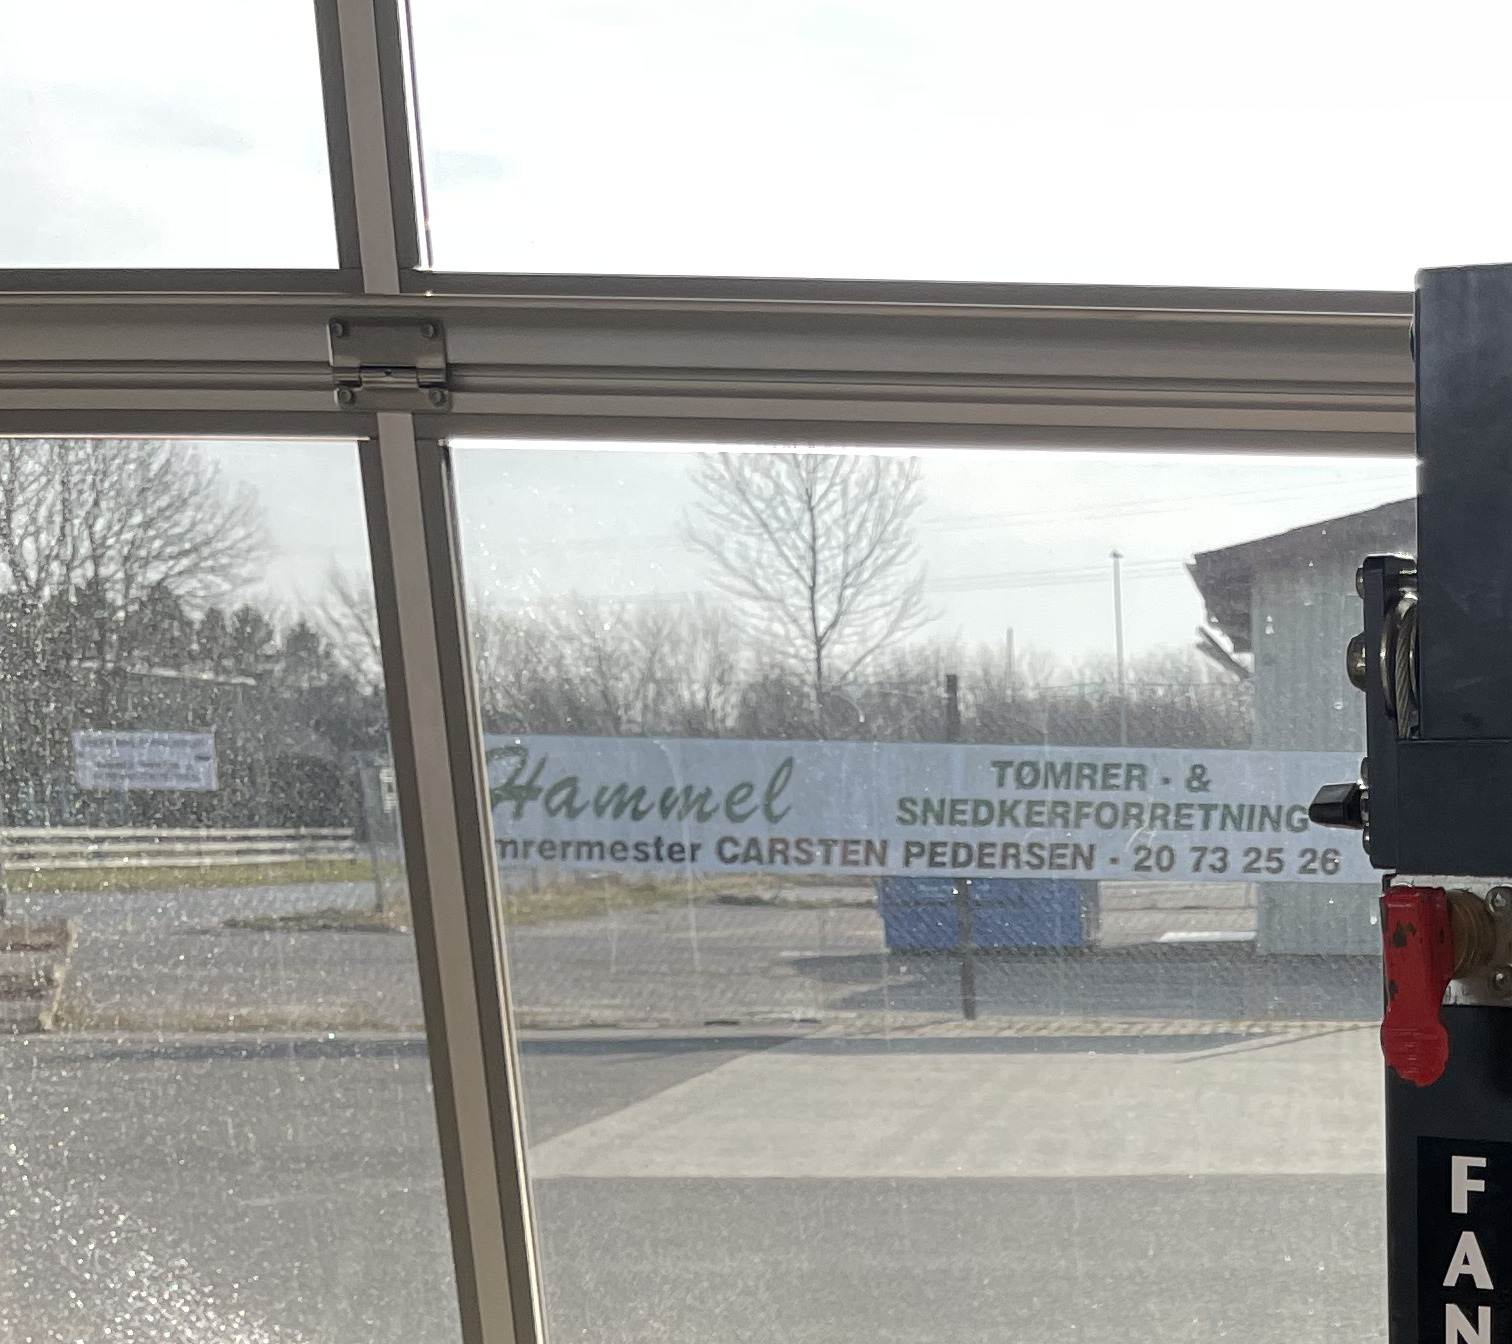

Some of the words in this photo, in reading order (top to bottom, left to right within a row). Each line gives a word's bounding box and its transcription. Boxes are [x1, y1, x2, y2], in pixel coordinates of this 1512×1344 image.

[485, 746, 794, 825] Hammel
[992, 760, 1150, 791] TØMRER
[1186, 764, 1211, 792] &
[897, 797, 1310, 832] SNEDKERFORRETNING
[717, 836, 888, 867] CARSTEN
[904, 841, 1095, 870] PEDERSEN
[1133, 846, 1175, 873] 20
[1191, 846, 1229, 873] 73
[1242, 847, 1284, 875] 25
[1298, 848, 1340, 875] 26
